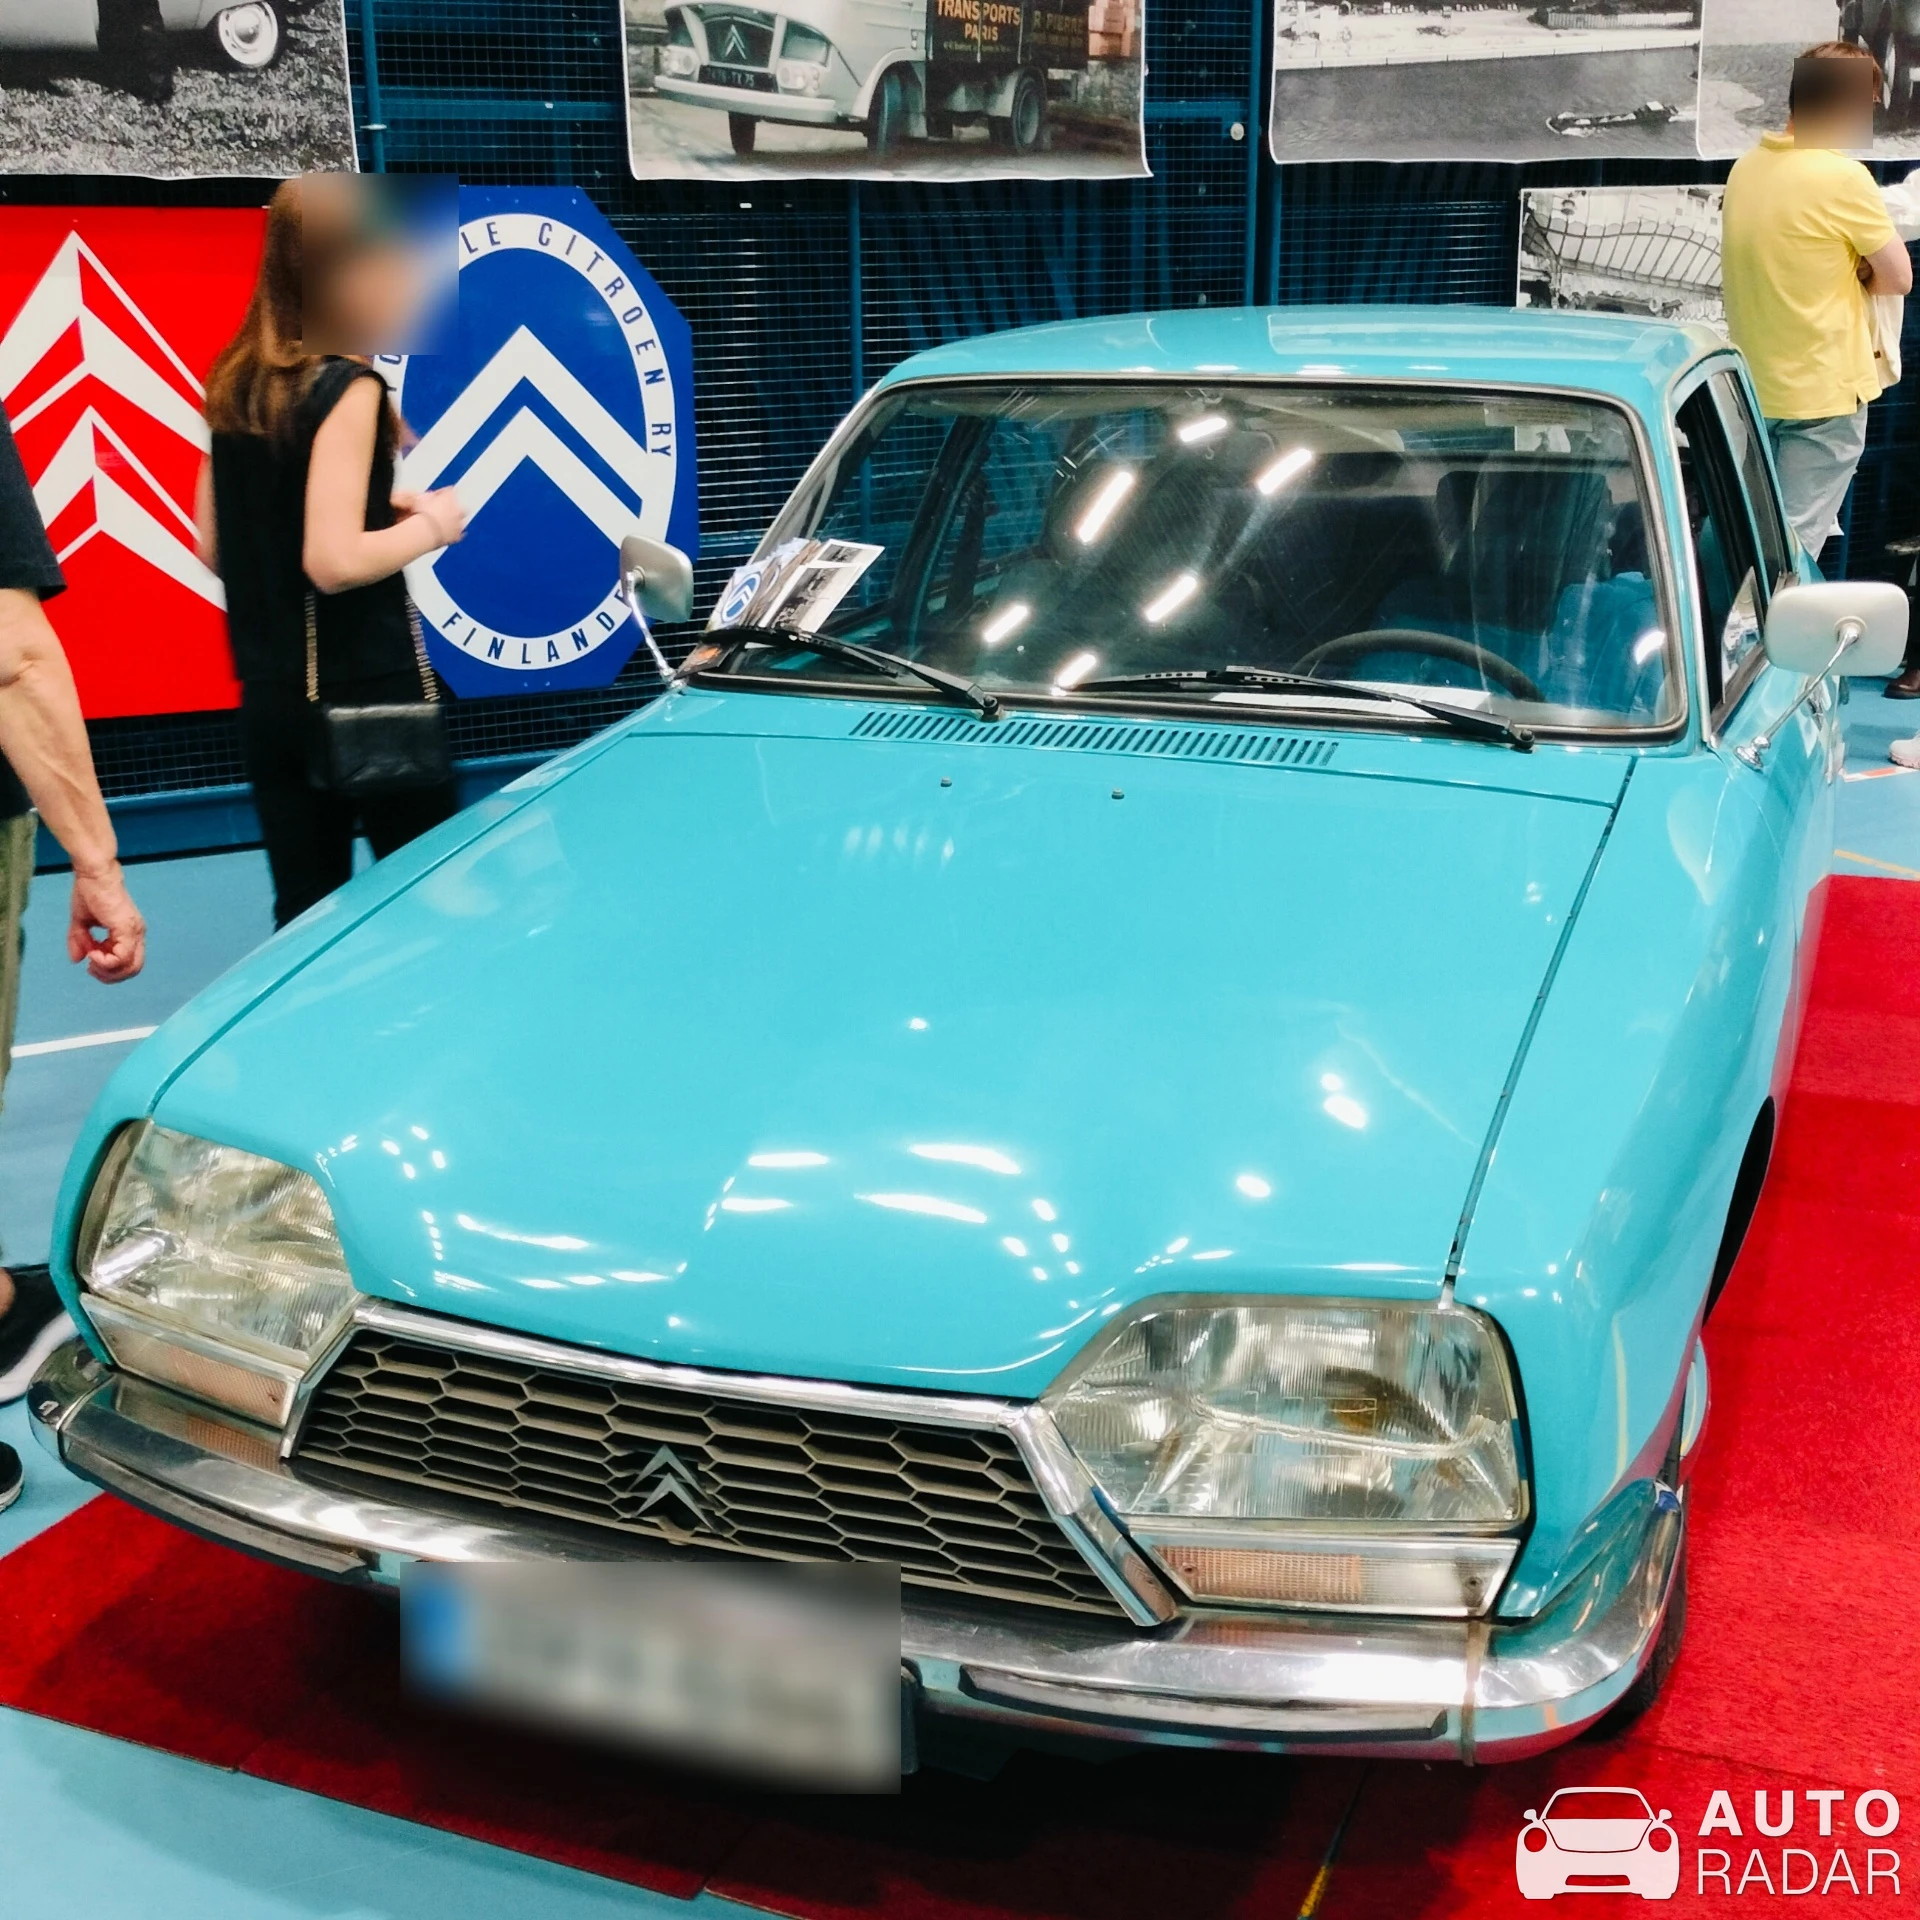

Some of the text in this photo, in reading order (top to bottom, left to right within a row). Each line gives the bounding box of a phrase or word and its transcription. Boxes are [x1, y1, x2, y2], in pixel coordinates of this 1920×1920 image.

[964, 23, 999, 41] PARIS
[538, 222, 666, 385] CITROEN
[651, 422, 672, 457] RY
